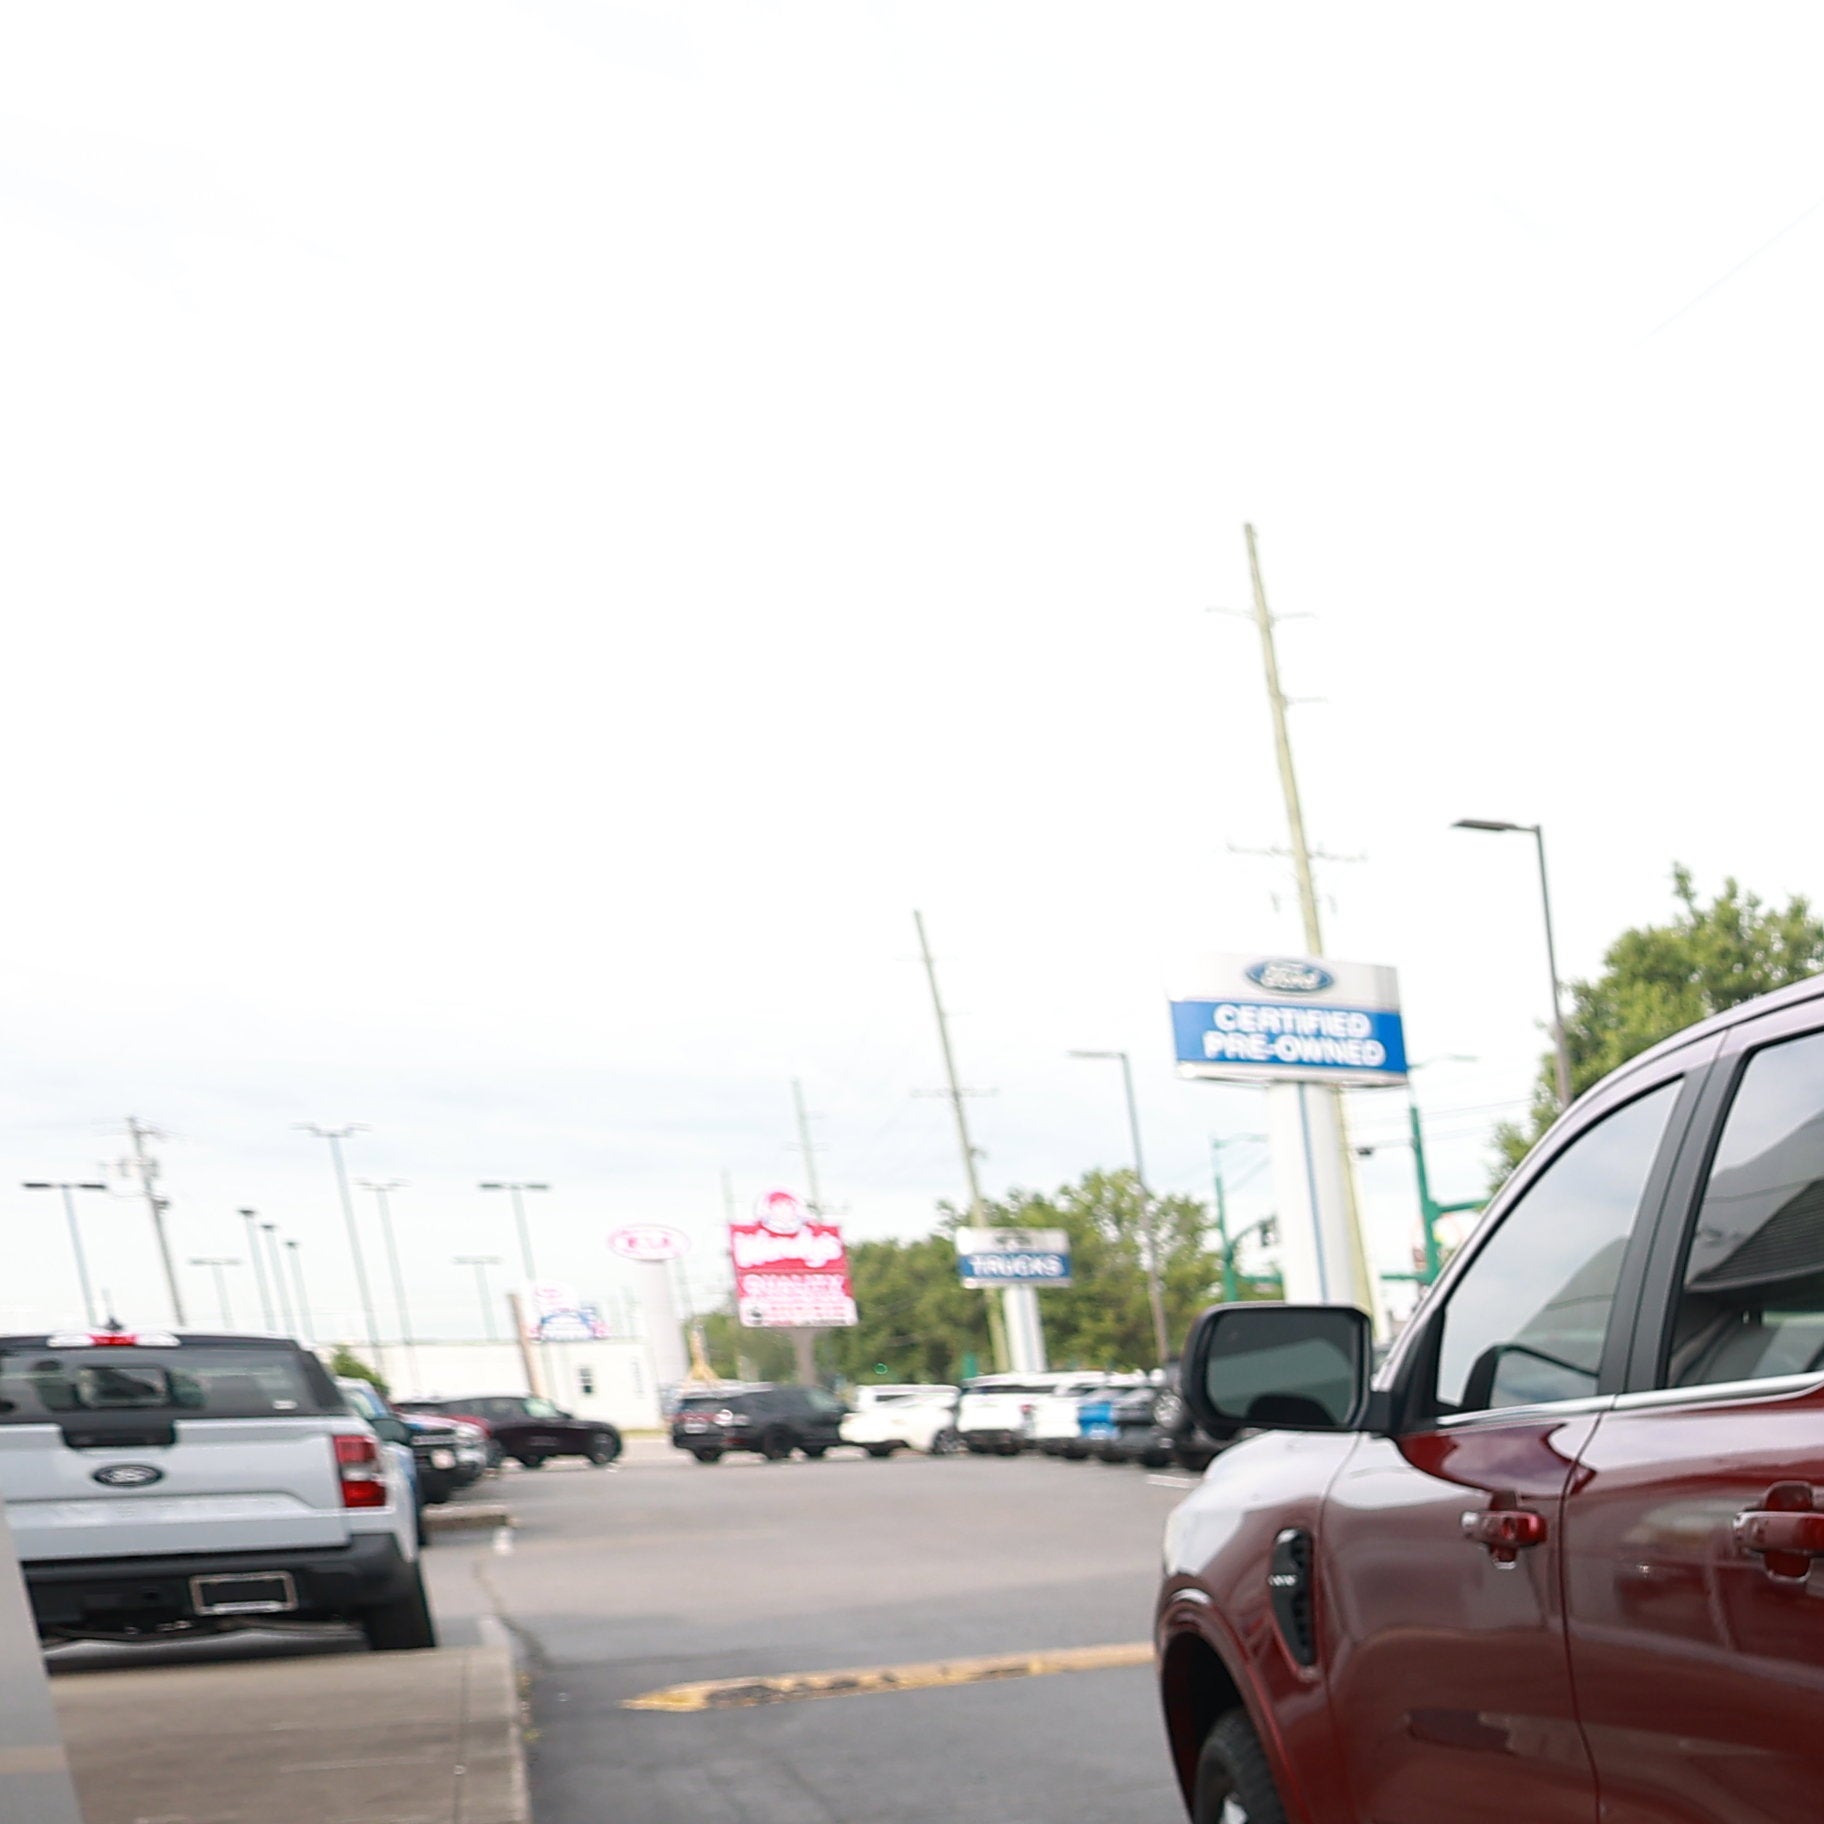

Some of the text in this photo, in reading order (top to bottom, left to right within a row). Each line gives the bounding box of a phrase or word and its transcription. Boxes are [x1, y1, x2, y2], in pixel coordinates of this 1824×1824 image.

[1213, 1003, 1372, 1038] CERTIFIED
[1203, 1030, 1386, 1067] PRE-OWNED
[970, 1254, 1064, 1277] TRUCKS
